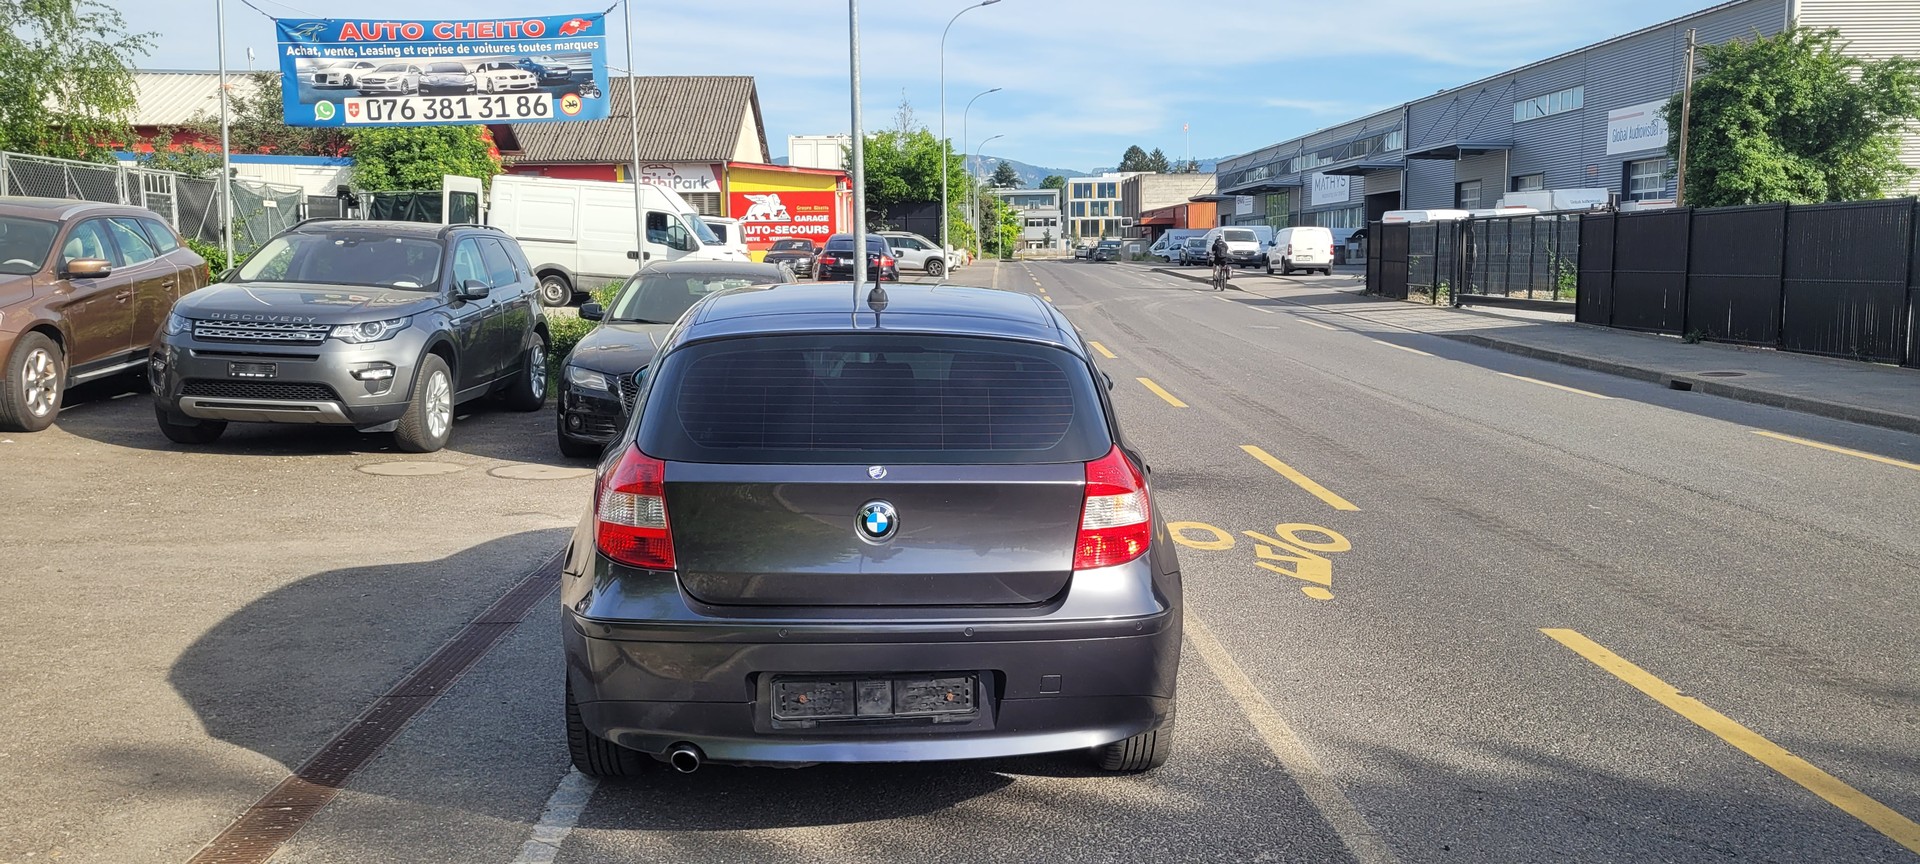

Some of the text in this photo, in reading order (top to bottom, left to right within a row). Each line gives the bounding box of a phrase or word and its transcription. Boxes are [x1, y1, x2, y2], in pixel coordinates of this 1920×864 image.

[339, 19, 546, 42] AUTO CHEITO
[286, 41, 599, 58] Achat, vente, Leasing et reprise de voitures toutes marques
[366, 95, 548, 121] 076 381 31 86
[1612, 126, 1628, 143] Global
[1314, 175, 1346, 191] MATHYS
[211, 312, 317, 323] DISCOVERY
[863, 506, 892, 518] BMW
